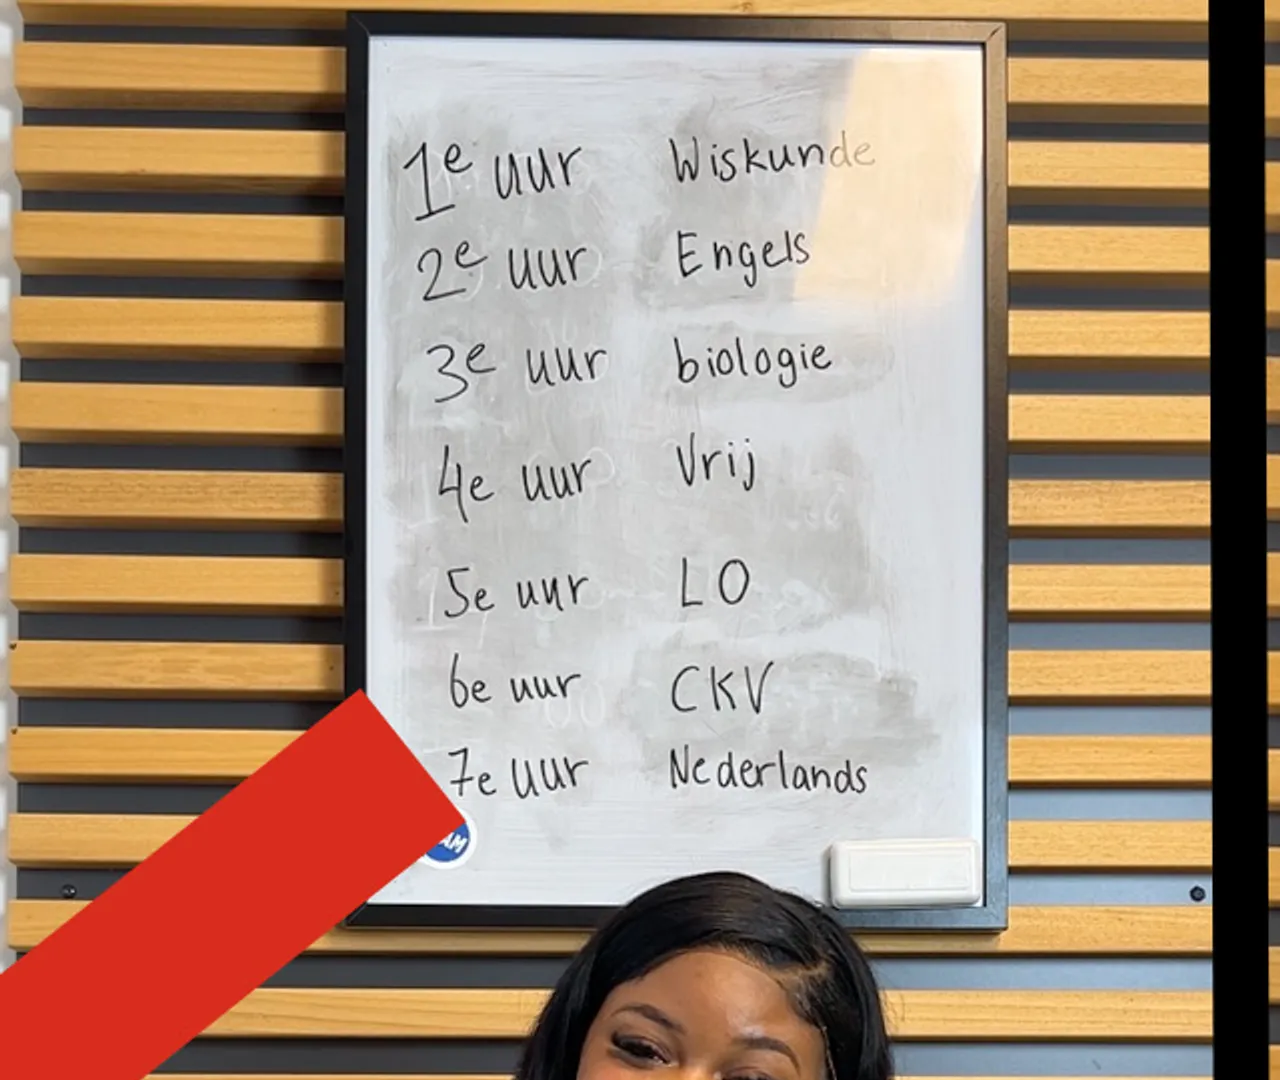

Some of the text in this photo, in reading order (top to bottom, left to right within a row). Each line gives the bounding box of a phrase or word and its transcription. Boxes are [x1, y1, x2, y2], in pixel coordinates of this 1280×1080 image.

[402, 134, 876, 222] 1e uur Wiskunde
[416, 229, 811, 302] 2e uur Engels
[425, 335, 833, 404] 3e uur biologie
[437, 431, 756, 524] 4e uur Vrij
[443, 556, 751, 619] 5e uur LO
[449, 652, 775, 716] 6e uur CKV
[447, 743, 868, 800] 7e uur Nederlands
